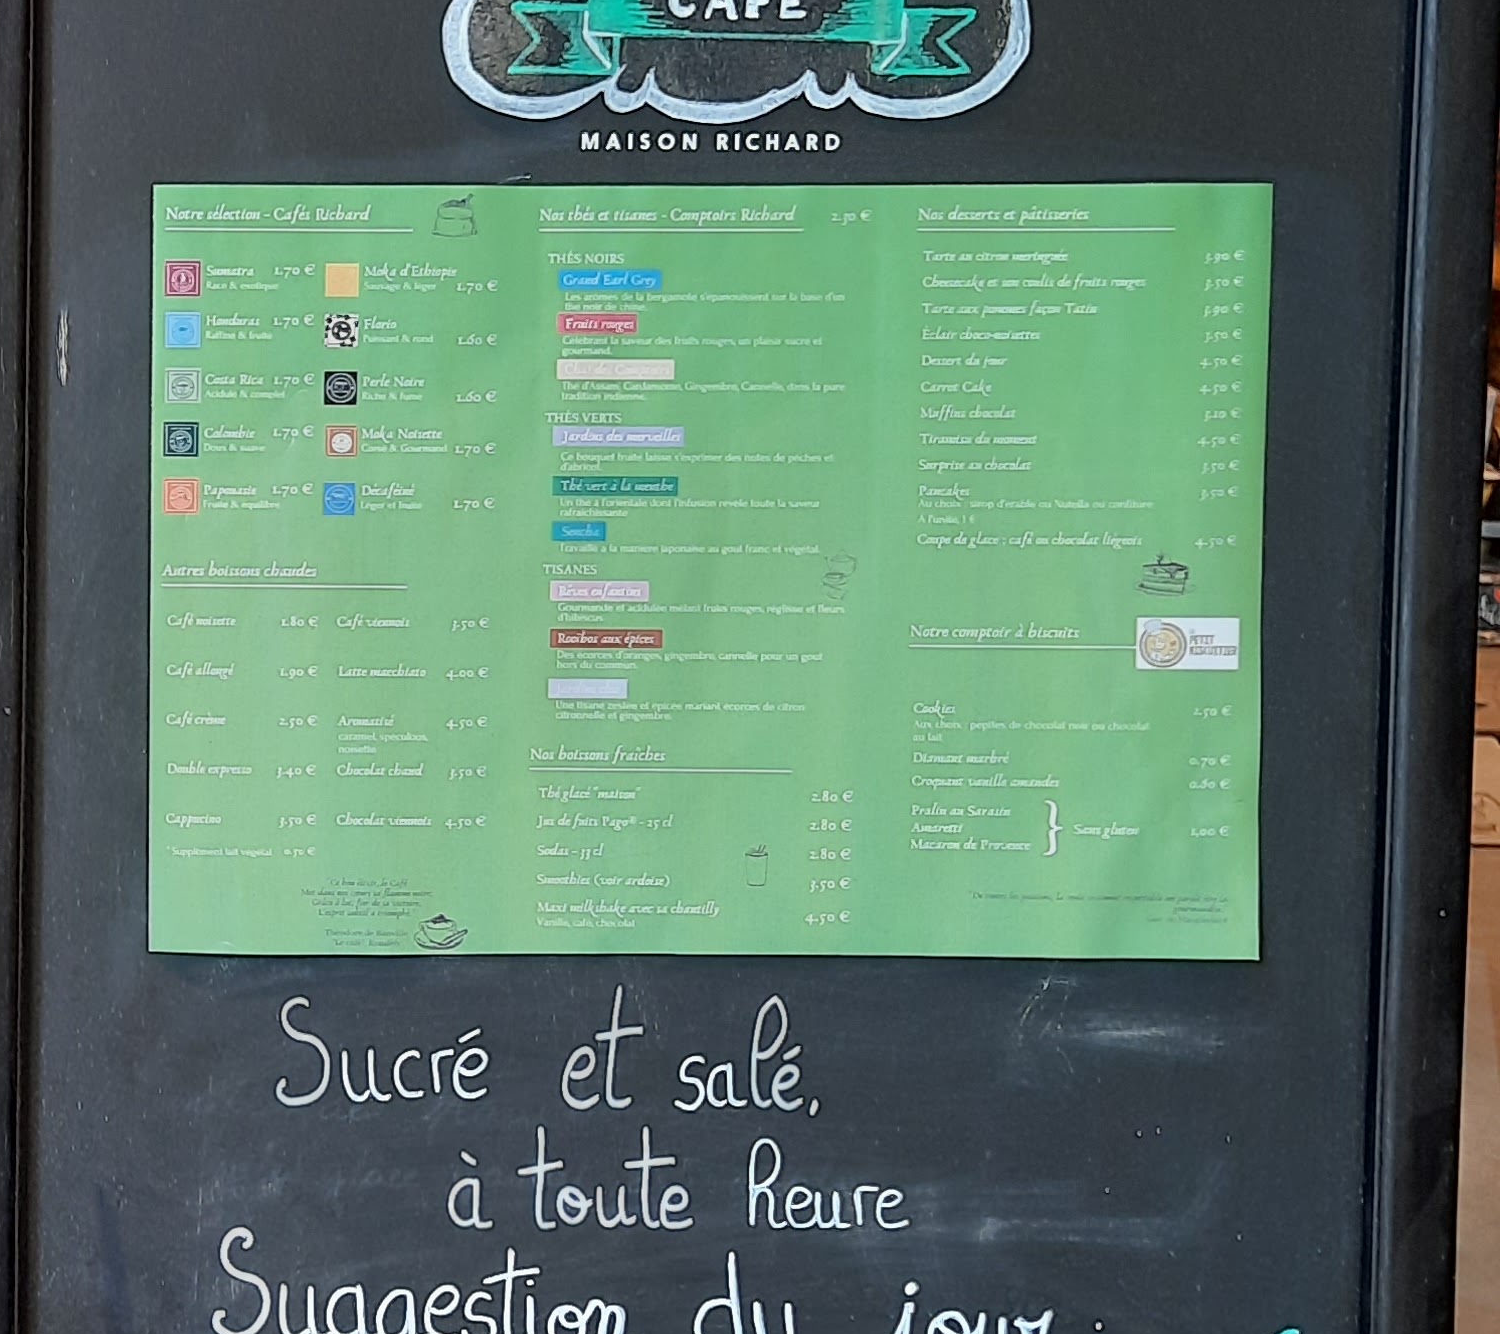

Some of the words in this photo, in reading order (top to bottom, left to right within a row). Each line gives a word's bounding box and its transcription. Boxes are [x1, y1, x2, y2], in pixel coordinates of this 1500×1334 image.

[580, 132, 700, 152] MAISON
[716, 132, 842, 152] RICHARD
[166, 206, 203, 221] Notre
[206, 204, 261, 221] sélection
[273, 205, 311, 222] Cafés
[315, 205, 371, 221] Richard
[539, 208, 564, 222] Nos
[567, 207, 595, 222] thés
[597, 211, 609, 222] et
[613, 210, 657, 222] tisanes
[670, 208, 736, 226] Comptoirs
[741, 205, 796, 222] Richard
[918, 208, 944, 221] Nos
[947, 206, 1000, 221] desserts
[1002, 210, 1016, 221] et
[1019, 205, 1090, 226] pâtisseries
[548, 251, 582, 264] THÉS
[584, 252, 625, 264] NOIRS
[603, 273, 628, 286] Earl
[546, 410, 579, 424] THÉS
[582, 412, 622, 424] VERTS
[161, 564, 205, 578] Autres
[208, 562, 260, 578] boissons
[263, 563, 317, 578] chaudes
[543, 563, 597, 575] TISANES
[910, 625, 949, 639] Notre
[952, 626, 1011, 644] comptoir
[1015, 624, 1024, 639] à
[1028, 624, 1080, 640] biscuits
[530, 748, 554, 762] Nos
[558, 746, 610, 762] boissons
[612, 745, 666, 764] fraîches
[273, 995, 488, 1113] Sucré
[560, 986, 643, 1113] et
[447, 1149, 491, 1229] à
[517, 1127, 695, 1234] toute
[748, 1139, 909, 1231] heure
